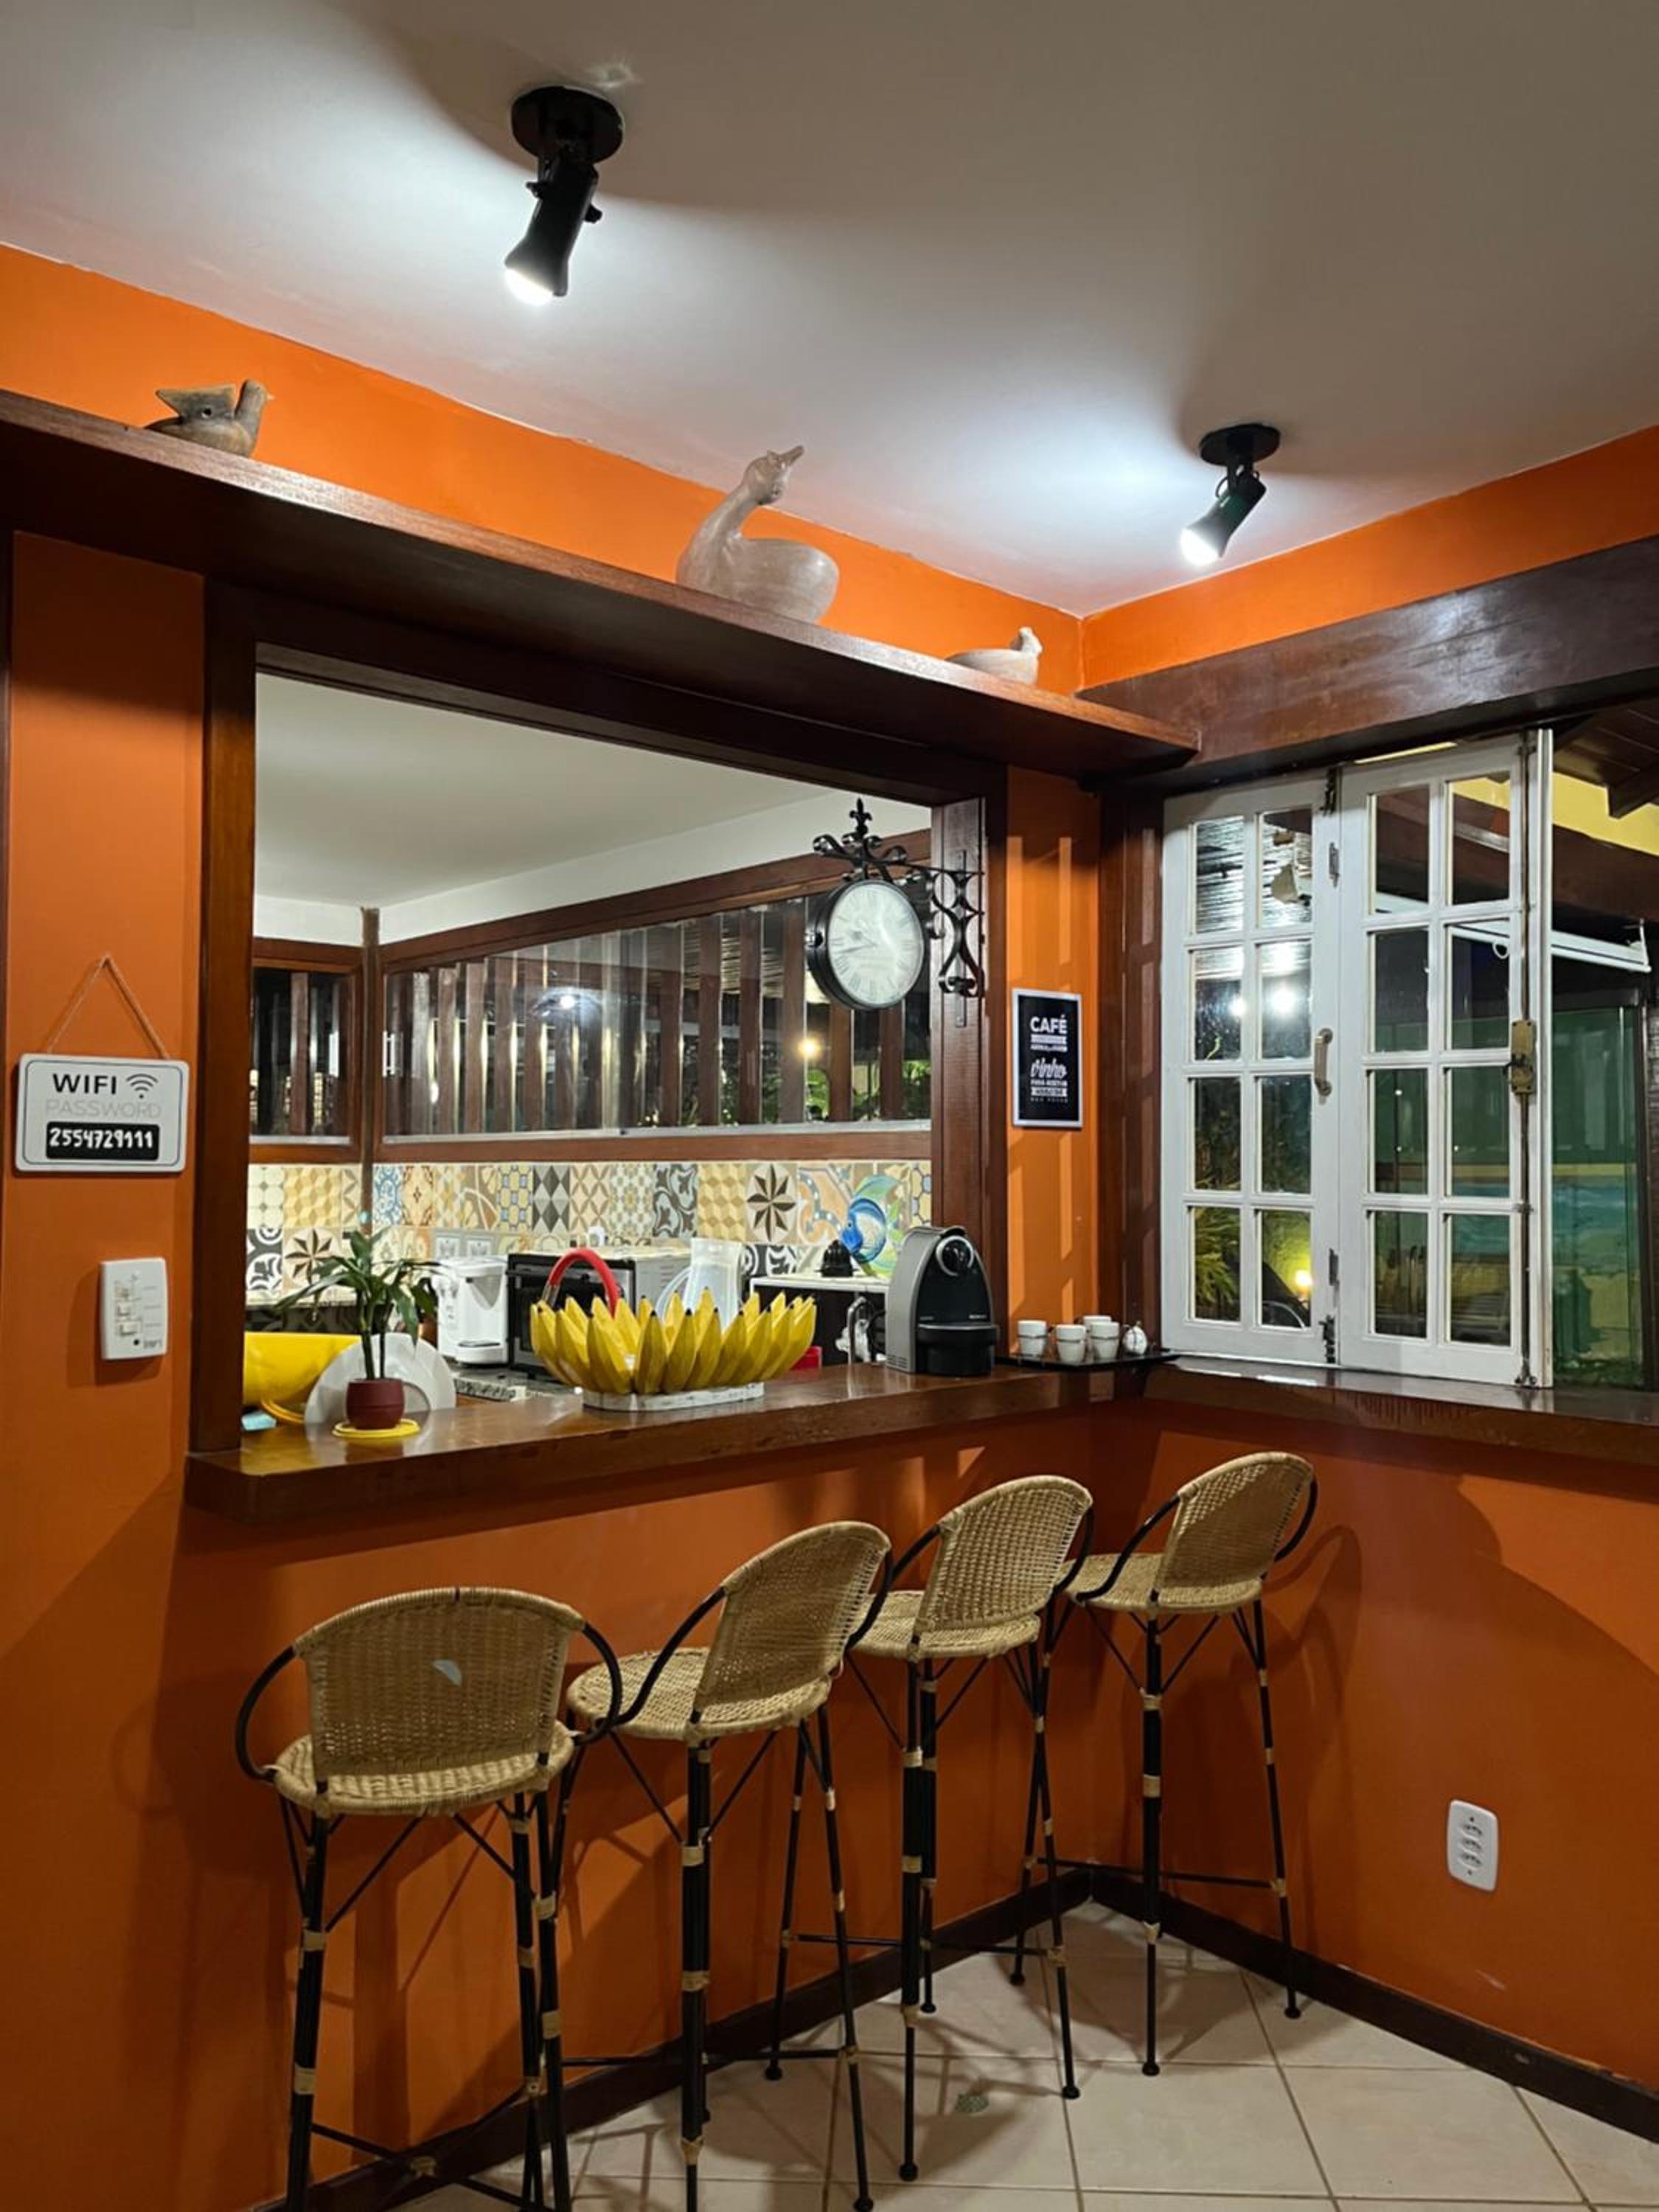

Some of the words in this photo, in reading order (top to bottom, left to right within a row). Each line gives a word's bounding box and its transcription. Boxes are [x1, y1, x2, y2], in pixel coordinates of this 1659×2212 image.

[1030, 1014, 1068, 1034] CAFÉ
[52, 1073, 117, 1095] WIFI
[45, 1099, 162, 1119] PASSWORD
[49, 1127, 153, 1149] 2554729111
